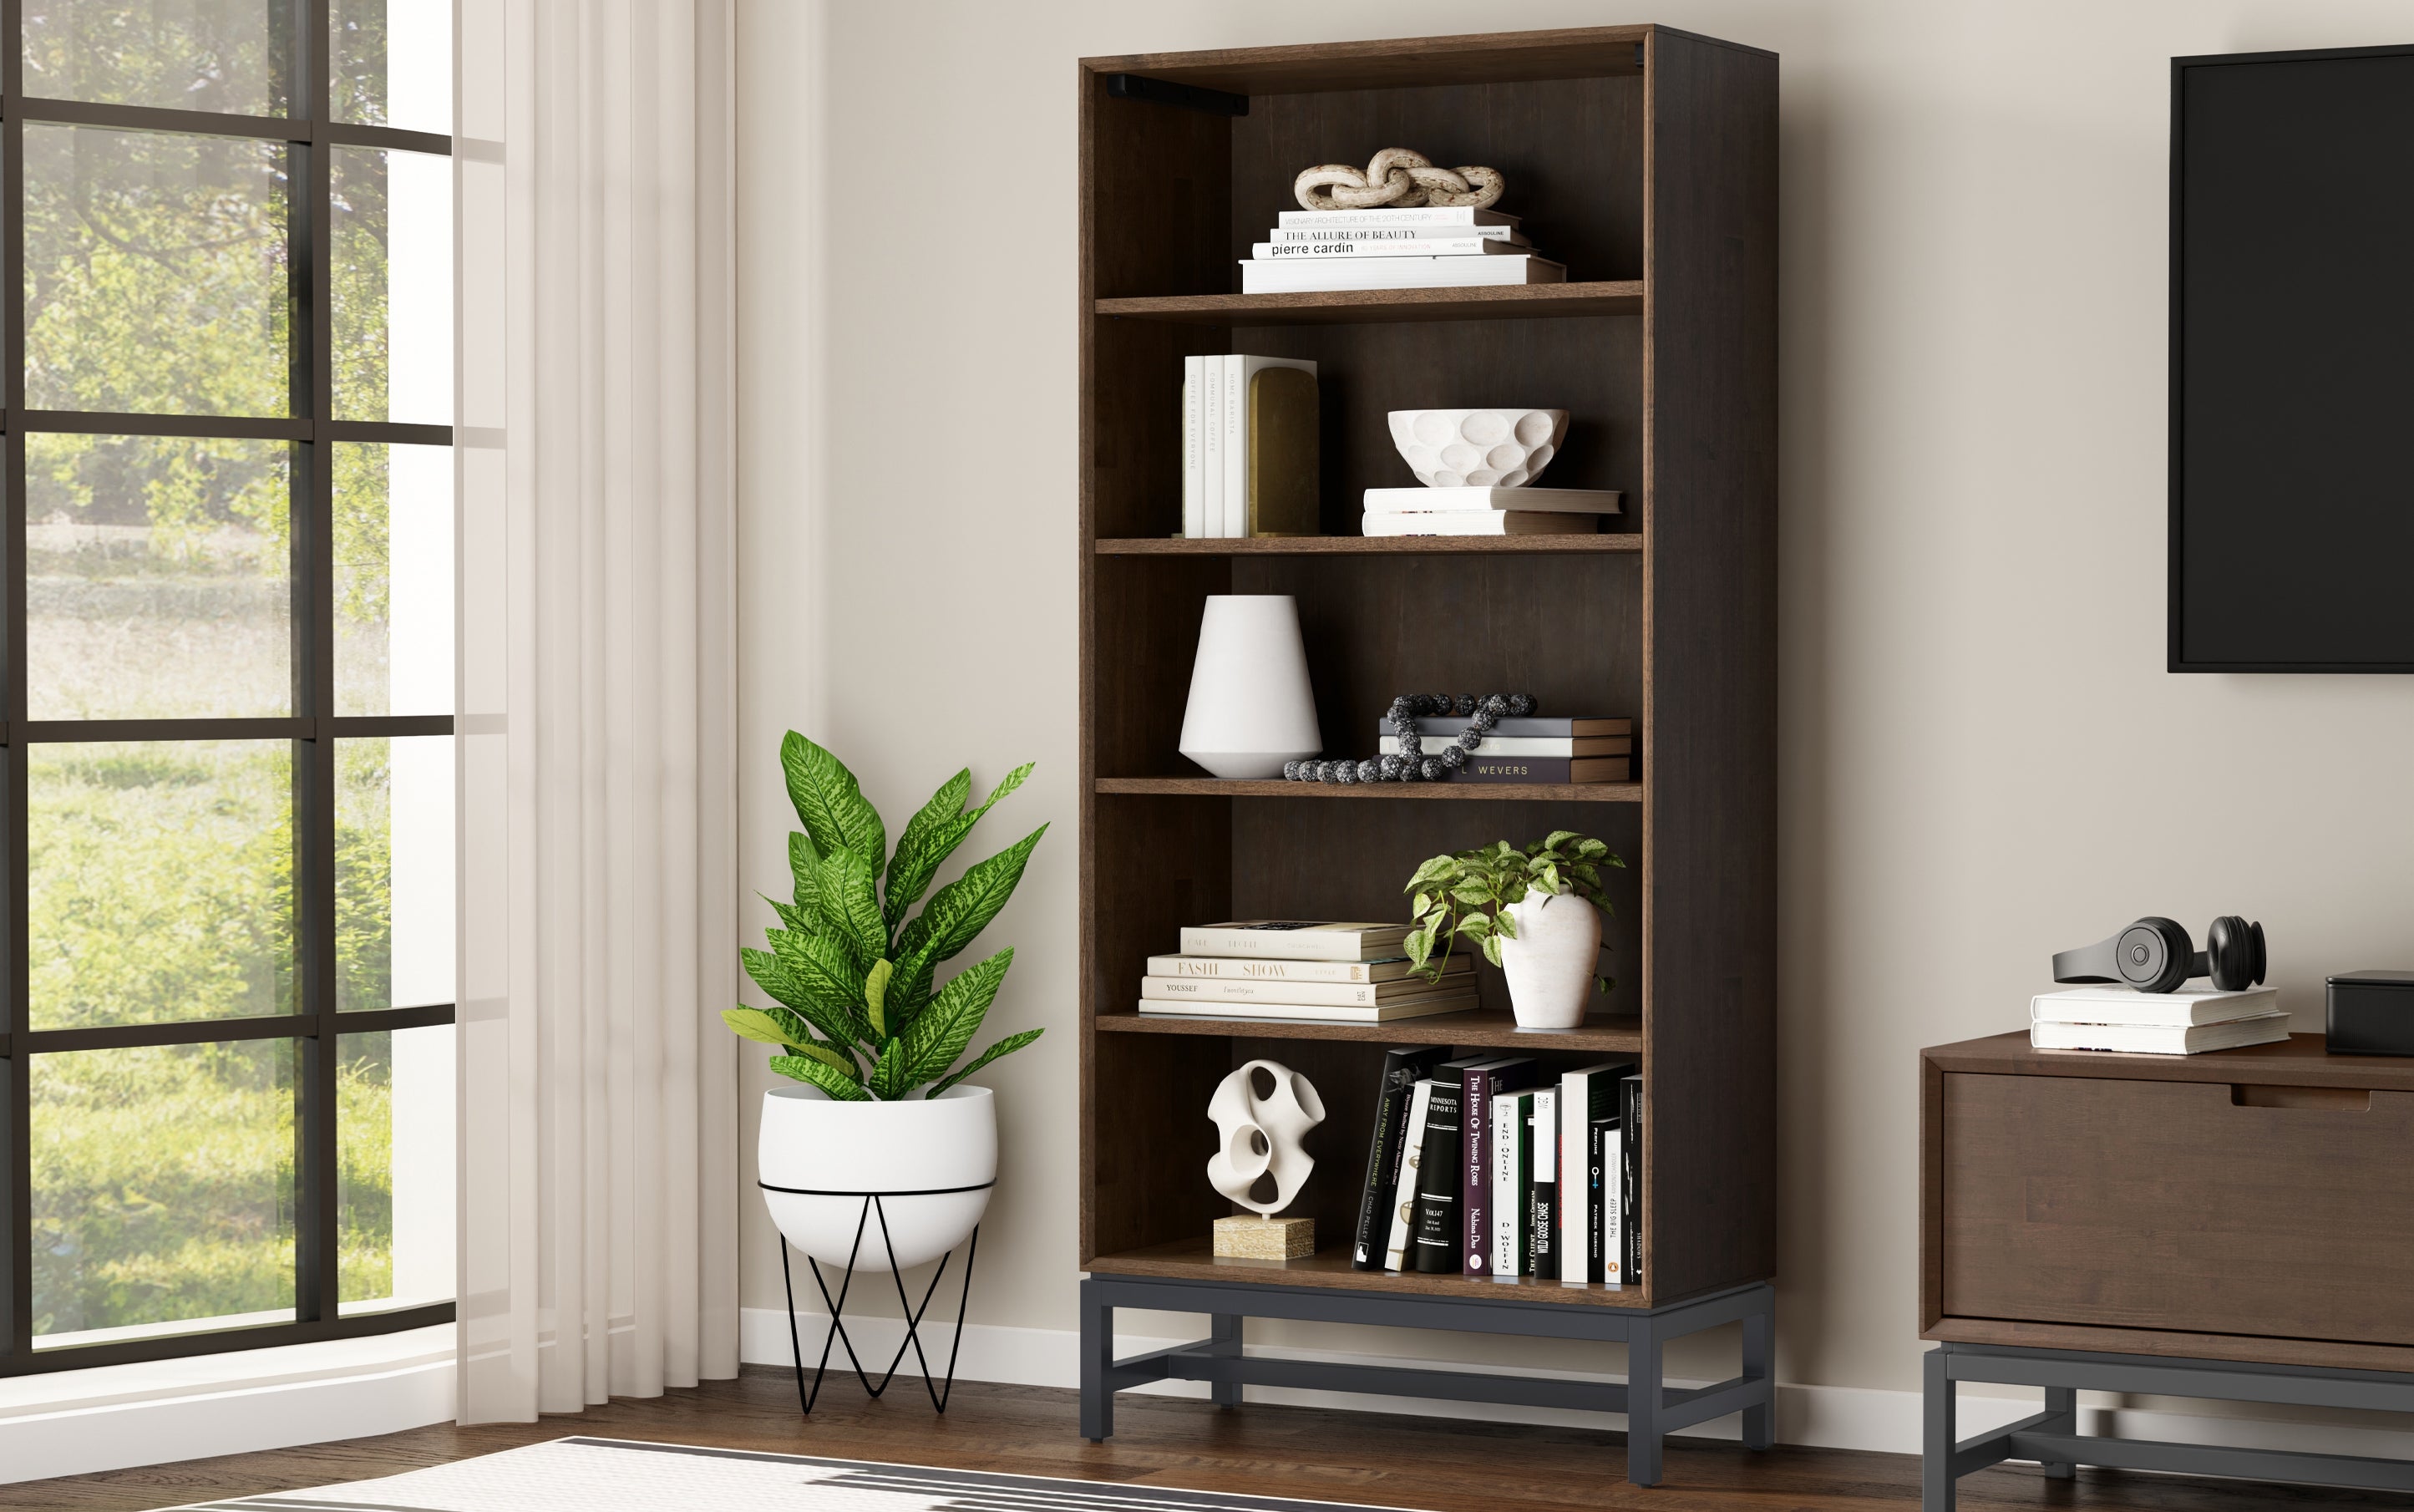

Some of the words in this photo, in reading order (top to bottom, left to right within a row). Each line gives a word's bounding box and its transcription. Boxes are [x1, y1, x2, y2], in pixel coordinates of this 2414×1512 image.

[1314, 216, 1359, 224] ARCHITECTURE
[1401, 213, 1432, 221] CENTURY
[1284, 231, 1306, 241] THE
[1310, 231, 1352, 241] ALLURE
[1355, 230, 1370, 240] OF
[1372, 230, 1417, 240] BEAUTY
[1271, 244, 1309, 256] pierre
[1313, 242, 1354, 254] cardin
[1478, 766, 1528, 775] WEVERS
[1166, 984, 1198, 992] YOUSSEF
[1470, 1076, 1480, 1091] THE
[1488, 1076, 1504, 1096] THE
[1382, 1097, 1391, 1117] AWAY
[1429, 1104, 1458, 1114] REPORTS
[1431, 1096, 1458, 1106] MINNESOTA
[1470, 1093, 1480, 1116] HOUSE
[1379, 1118, 1387, 1139] FROM
[1470, 1118, 1480, 1129] OF
[1470, 1131, 1480, 1164] TWINING
[1371, 1140, 1383, 1187] EVERYWHERE
[1470, 1165, 1480, 1186] ROSES
[1366, 1196, 1374, 1215] CHAD
[1537, 1202, 1549, 1220] CHASE
[1362, 1215, 1371, 1240] PELLEY
[1471, 1208, 1480, 1234] Nabina
[1537, 1220, 1549, 1239] GOOSE
[1471, 1235, 1480, 1249] Das
[1537, 1240, 1549, 1254] WILD
